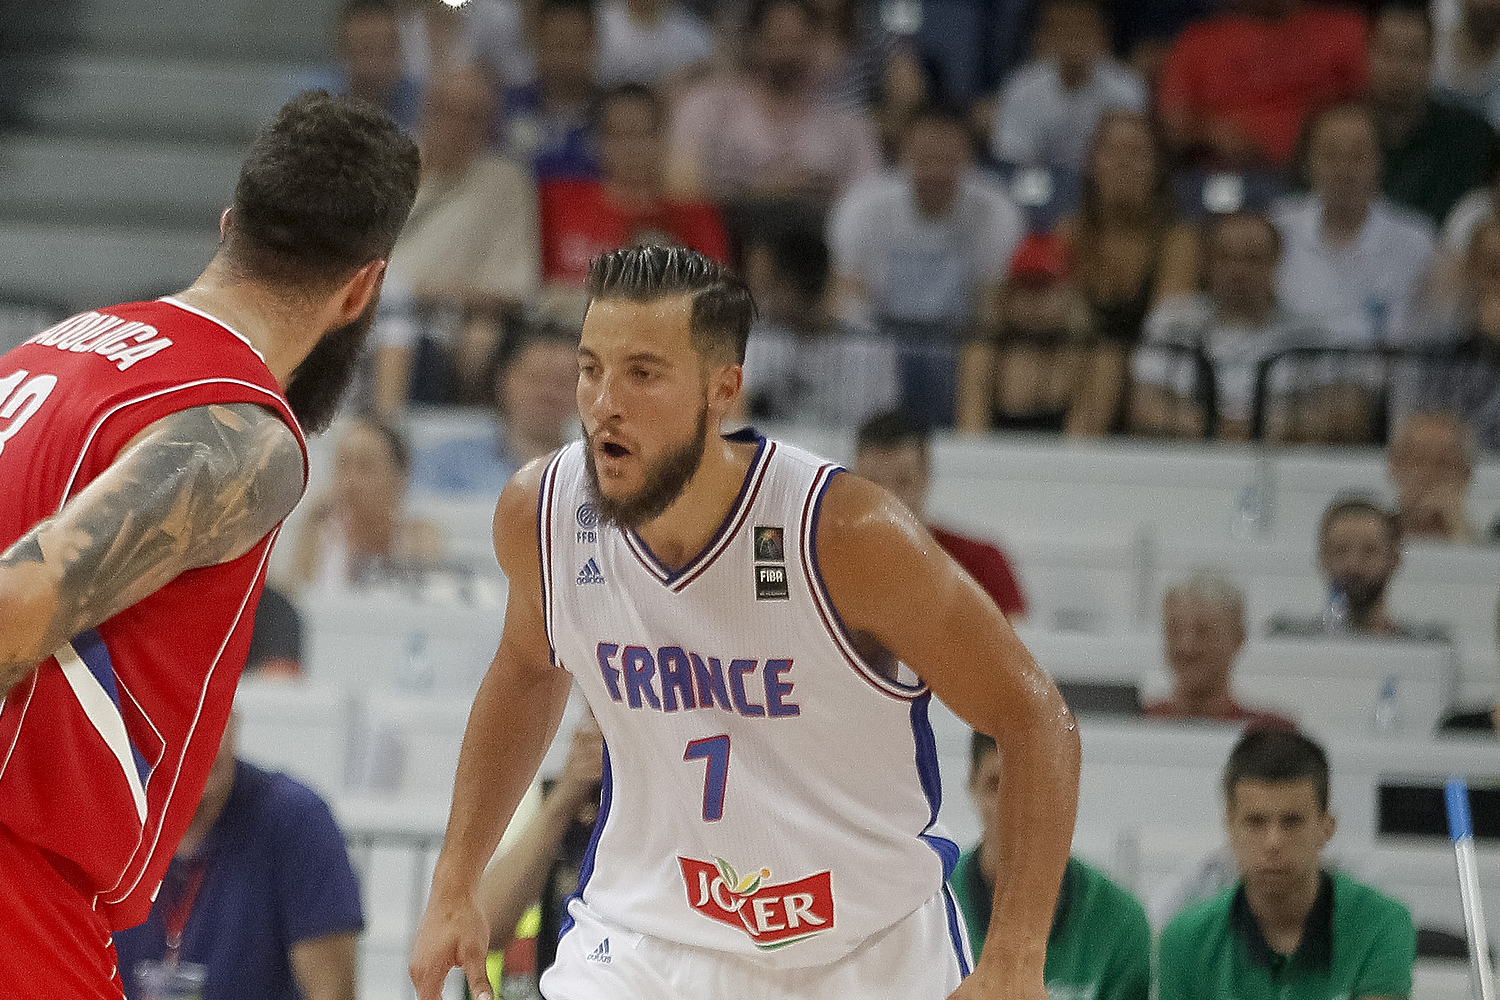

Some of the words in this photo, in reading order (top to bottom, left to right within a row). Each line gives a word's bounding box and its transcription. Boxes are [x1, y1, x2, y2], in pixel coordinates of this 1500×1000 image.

[760, 570, 783, 583] FIBA
[596, 642, 801, 718] FRANCE
[683, 735, 731, 823] 7
[696, 871, 827, 936] JOKER
